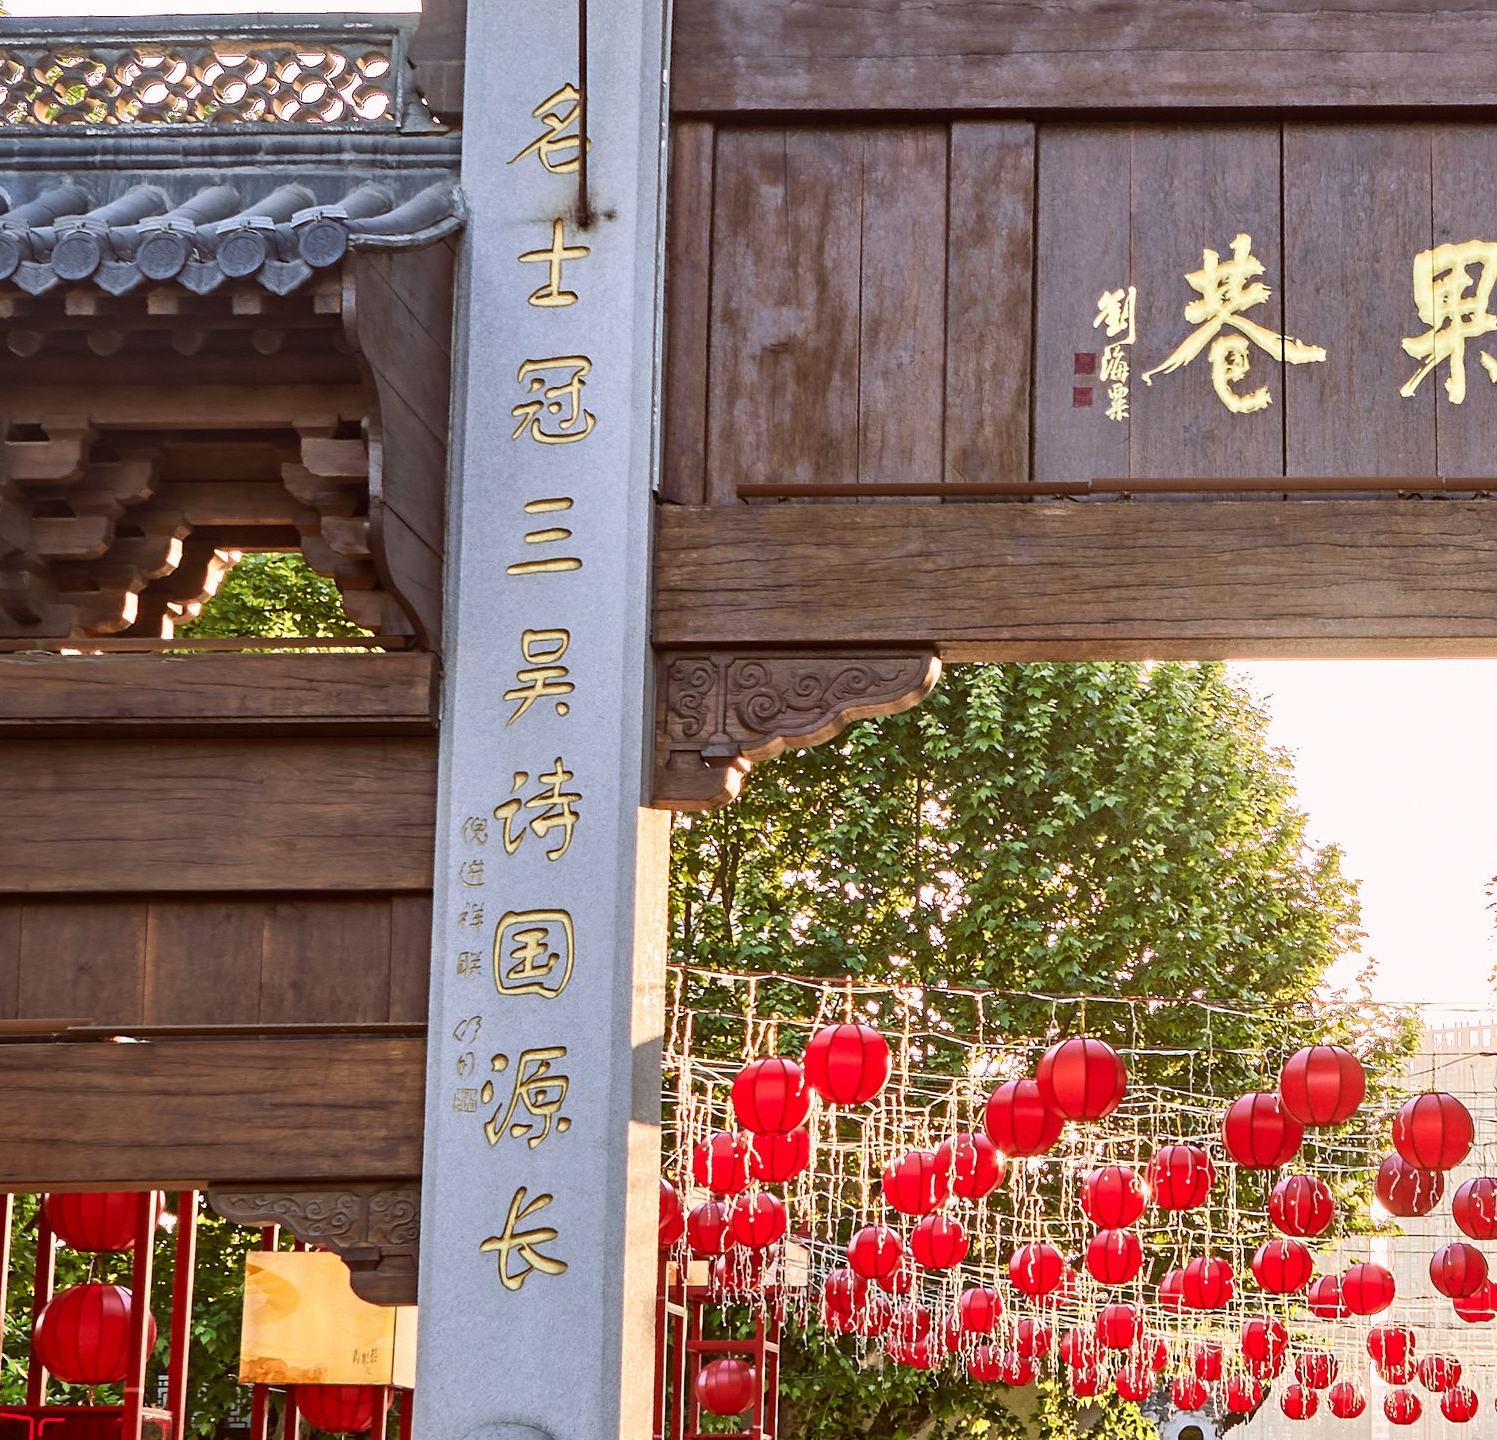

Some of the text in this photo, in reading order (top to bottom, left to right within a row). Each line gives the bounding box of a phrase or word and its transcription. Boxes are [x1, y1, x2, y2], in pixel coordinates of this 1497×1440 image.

[480, 82, 597, 1293] 名士冠三吴诗国源长
